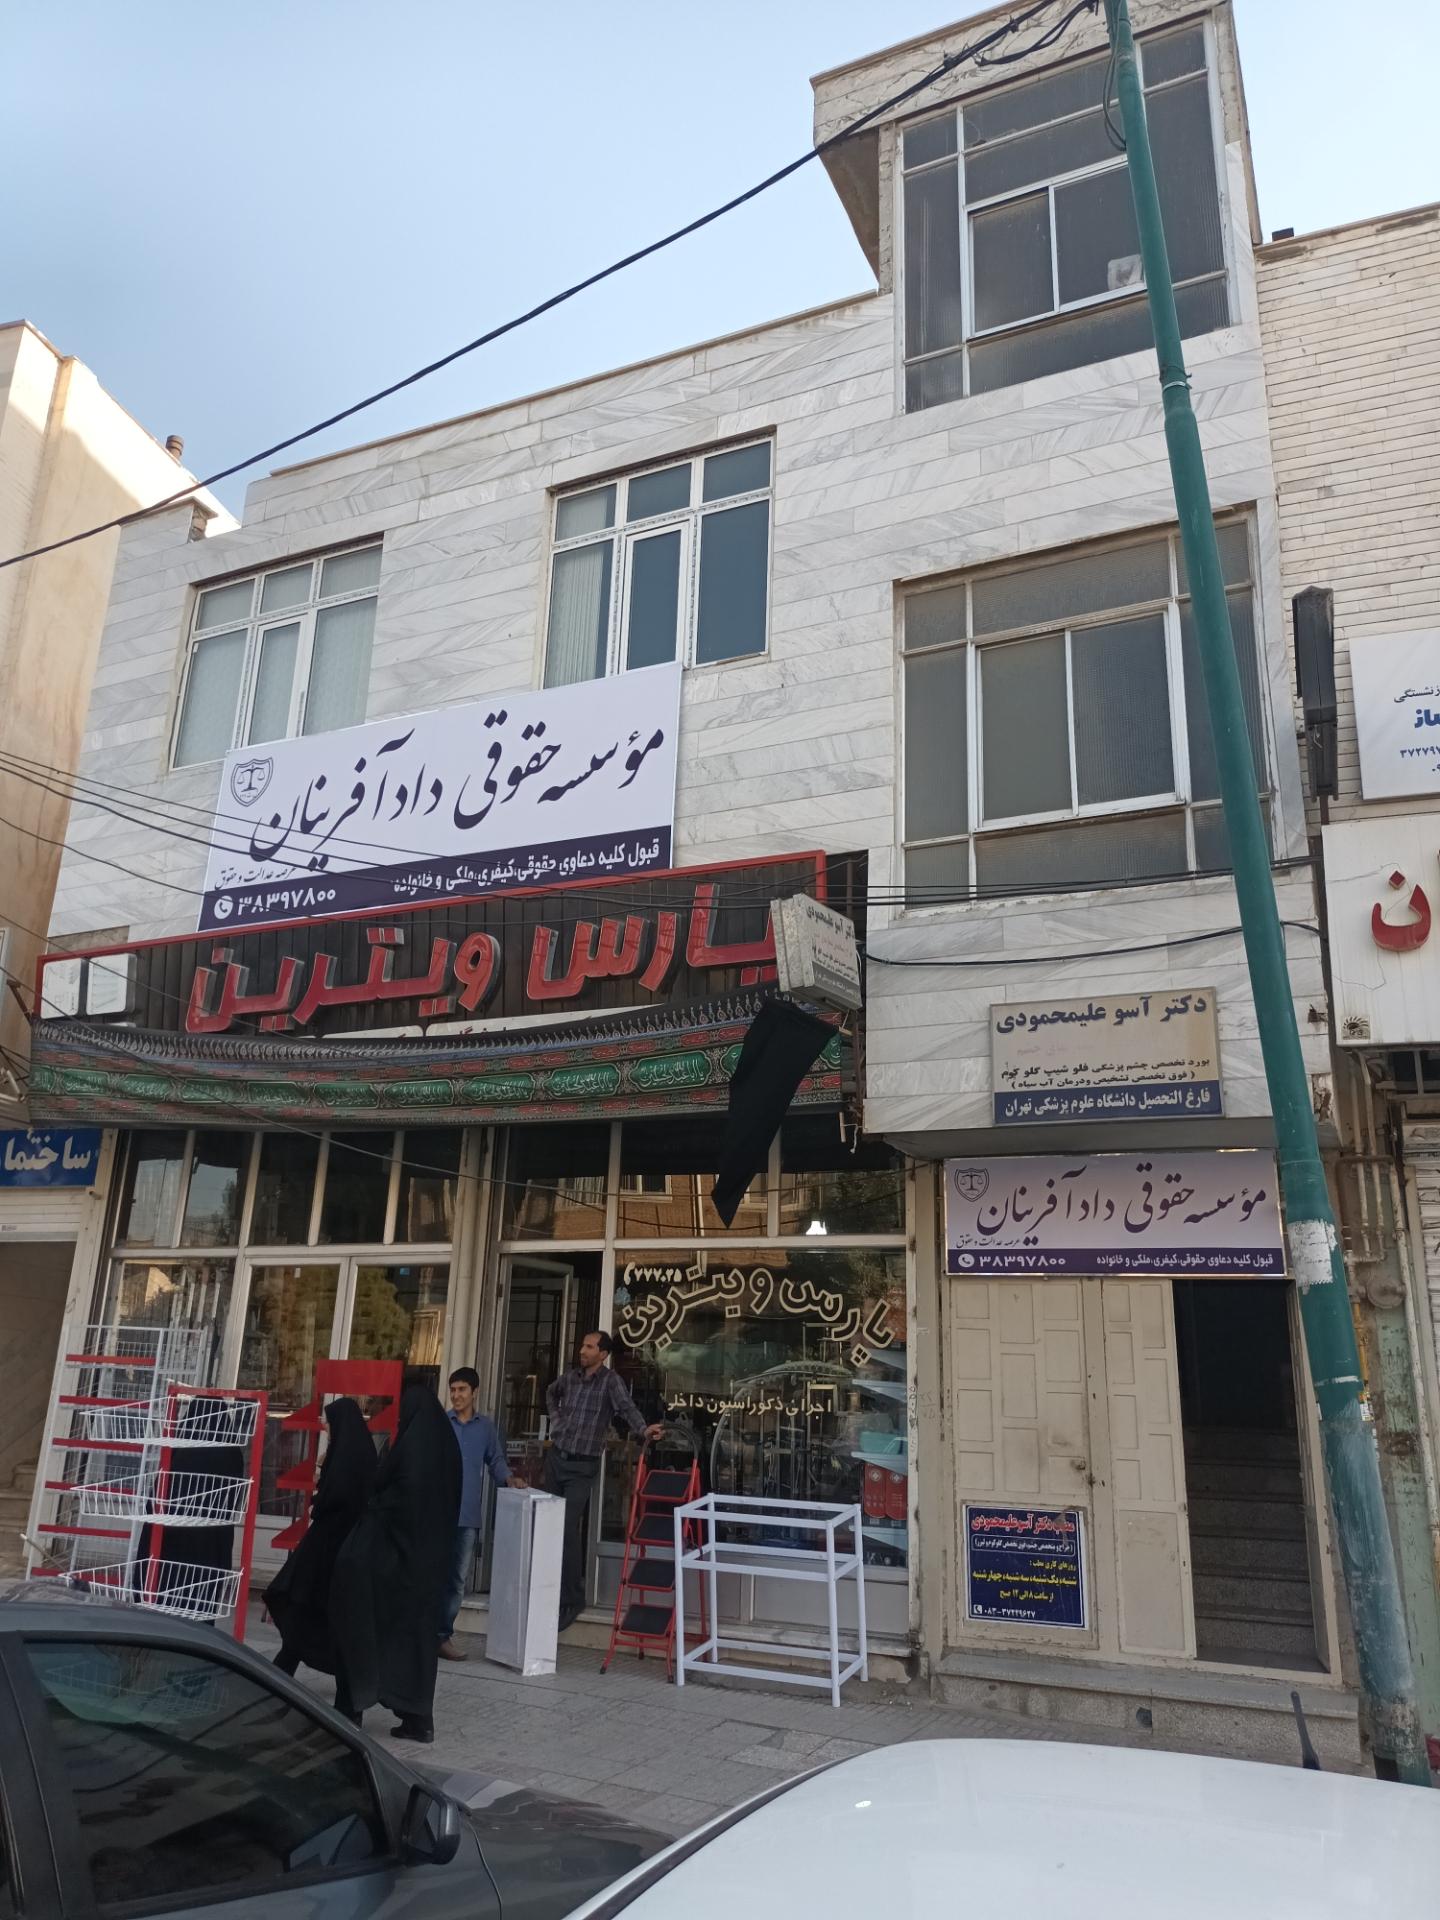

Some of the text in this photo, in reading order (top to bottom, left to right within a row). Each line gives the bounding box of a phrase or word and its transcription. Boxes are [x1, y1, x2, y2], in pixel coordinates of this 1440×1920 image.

[453, 710, 562, 830] حقوقی
[559, 850, 595, 876] دعاوی
[598, 843, 626, 870] کلیه
[628, 838, 660, 868] قبول
[393, 870, 433, 896] خانواده
[435, 874, 442, 892] و
[237, 887, 336, 916] ۳۸۳۹۷۸۰۰
[527, 883, 779, 1001] پارس
[185, 926, 500, 1034] ویترین
[1113, 996, 1153, 1026] آسو
[1160, 994, 1208, 1022] دکتر
[1091, 1062, 1125, 1073] پزشکی
[1126, 1061, 1148, 1072] چشم
[1188, 1057, 1210, 1068] بورد
[1005, 1088, 1211, 1117] فارغ التحصیل دانشگاه علوم پزشکی تهران
[0, 1130, 91, 1171] ساختما
[1124, 1162, 1195, 1233] حقوقی
[979, 1255, 1066, 1268] ۳۸۳۹۷۸۰۰
[1096, 1253, 1124, 1267] خانواده
[1125, 1257, 1130, 1267] و
[1207, 1254, 1232, 1267] دعاوی
[1233, 1254, 1252, 1267] کلیه
[1252, 1253, 1274, 1268] قبول
[619, 1264, 896, 1368] پارس ویترین
